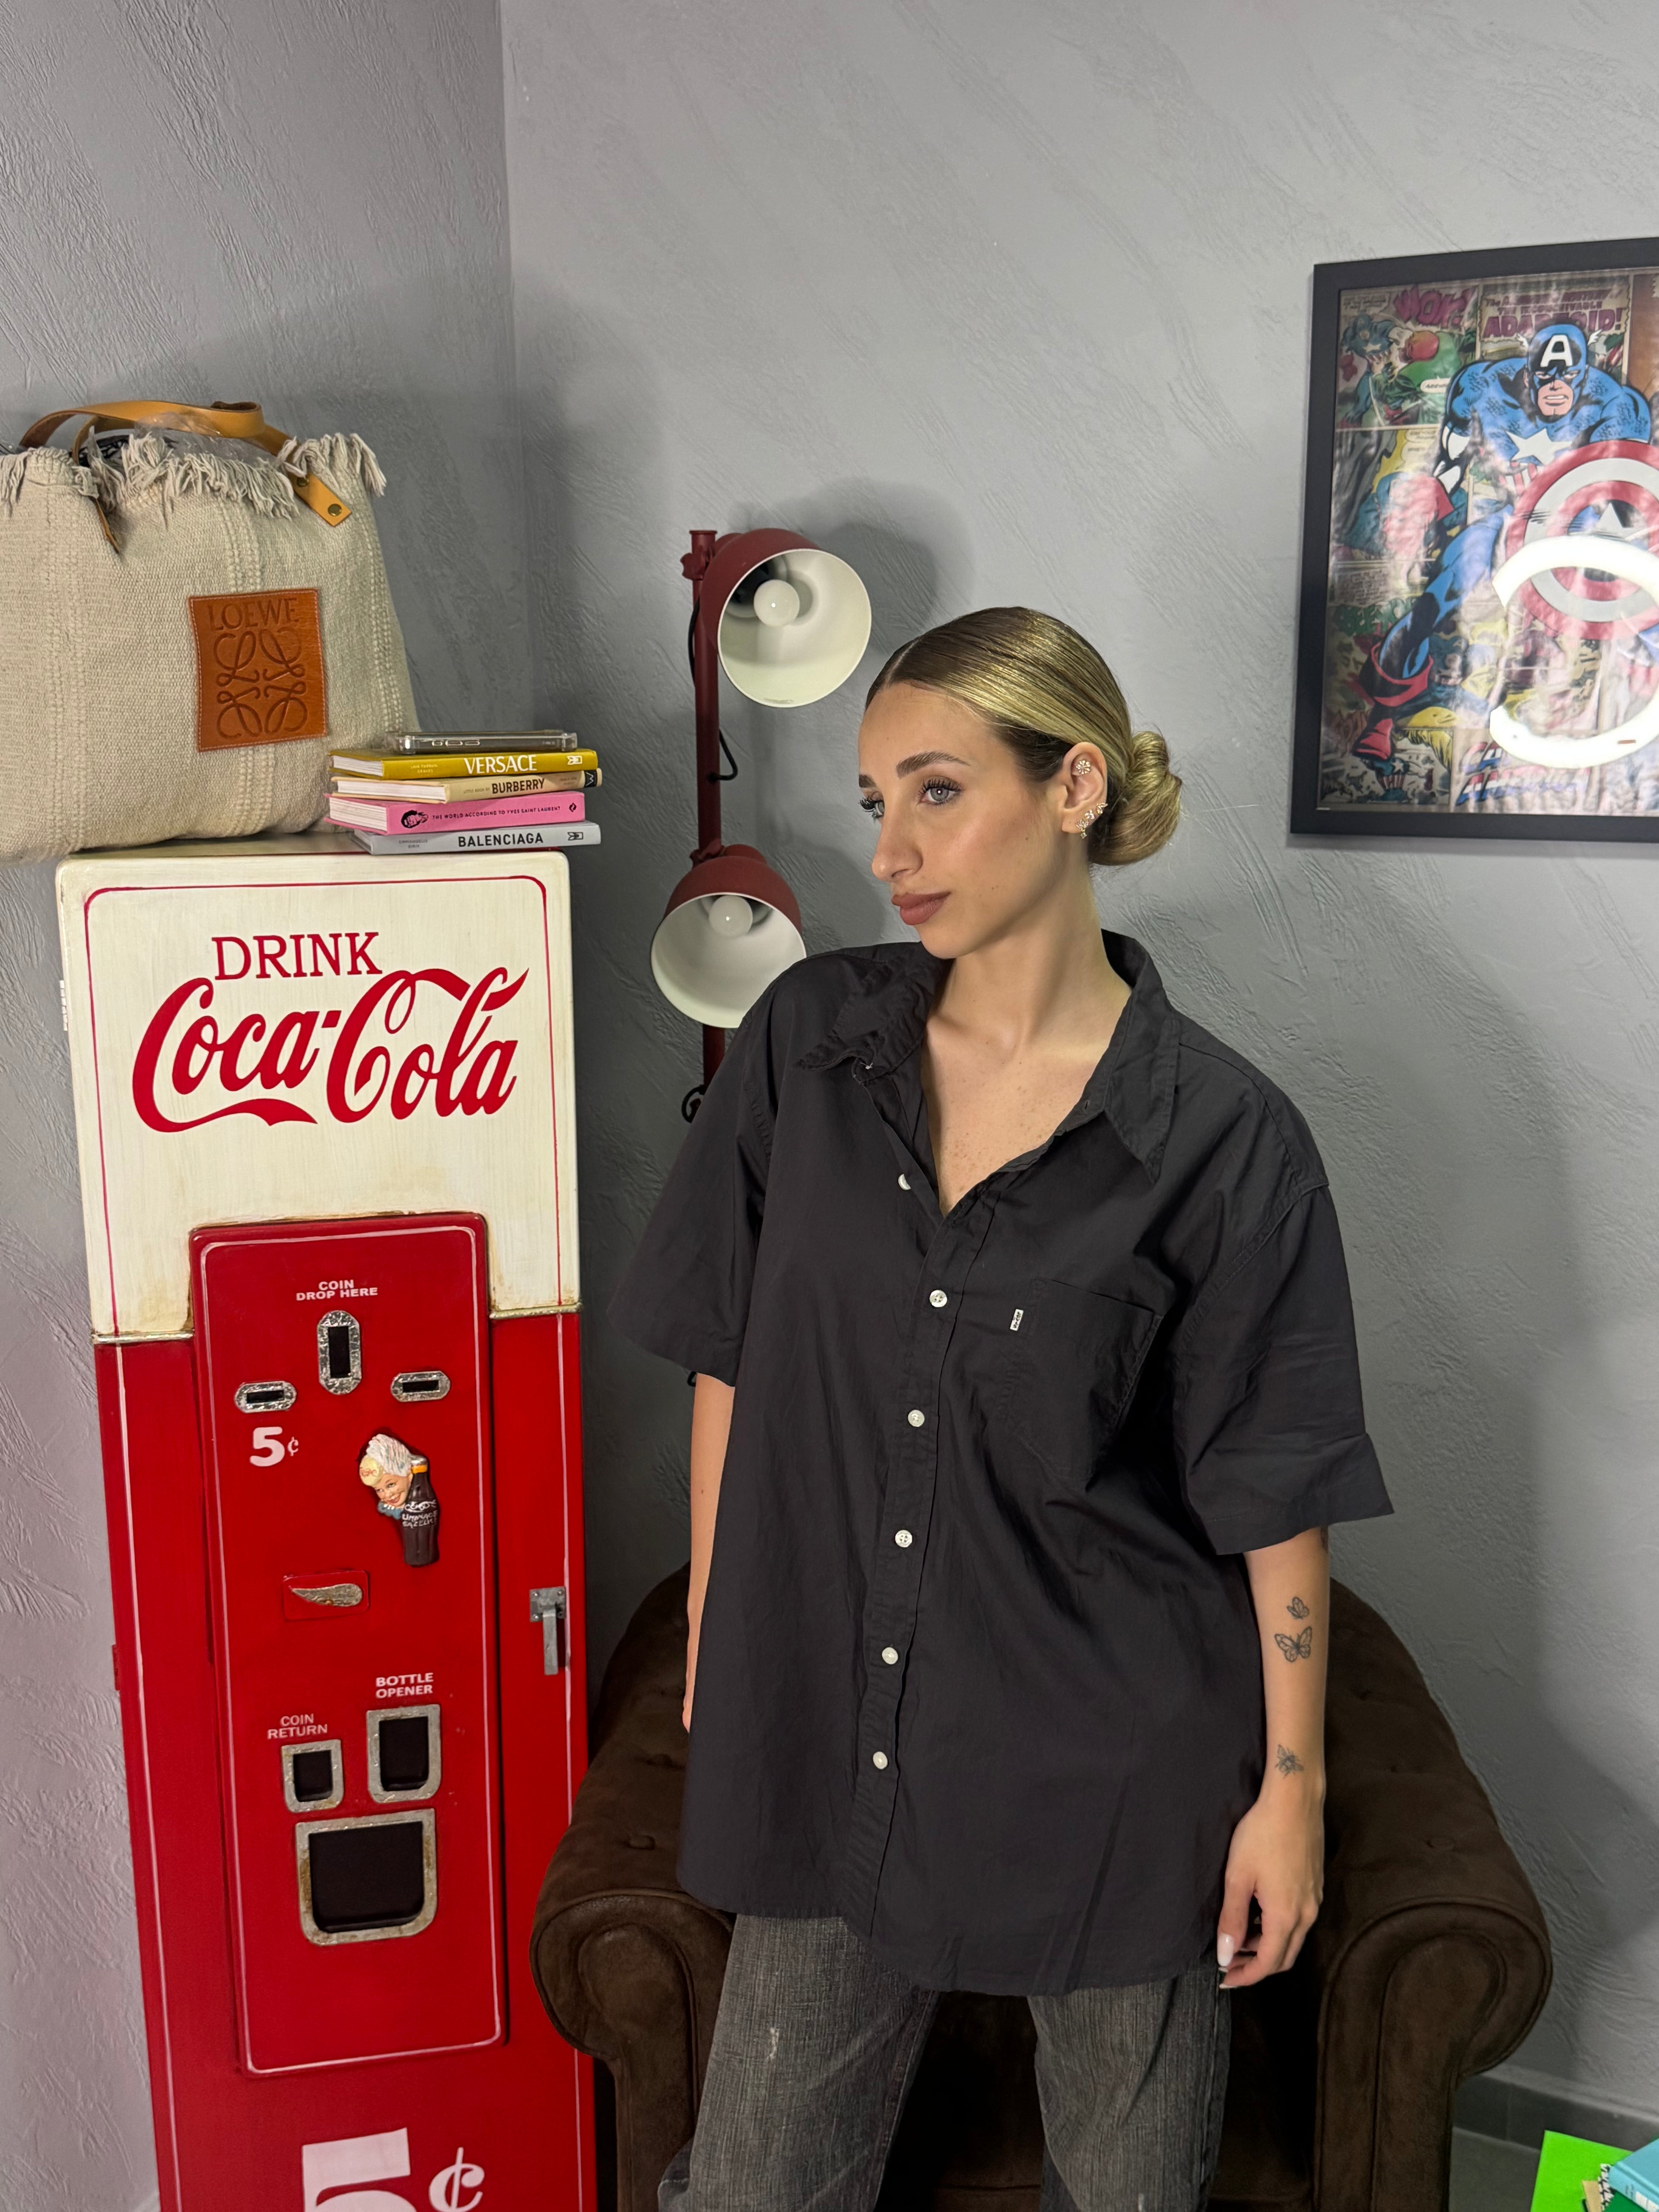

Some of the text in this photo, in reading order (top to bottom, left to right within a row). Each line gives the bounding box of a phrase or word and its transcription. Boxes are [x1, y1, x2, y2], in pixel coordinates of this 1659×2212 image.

[207, 597, 299, 631] LOEWE
[464, 754, 537, 774] VERSACE
[492, 778, 545, 794] BURBERRY
[458, 833, 543, 847] BALENCIAGA
[212, 932, 383, 980] DRINK
[132, 967, 529, 1132] Coca-Cola
[318, 1279, 354, 1291] COIN
[296, 1287, 378, 1301] DROP HERE
[375, 1672, 434, 1687] BOTTLE
[375, 1685, 433, 1699] OPENER
[280, 1713, 314, 1727] COIN
[267, 1724, 328, 1739] RETURN
